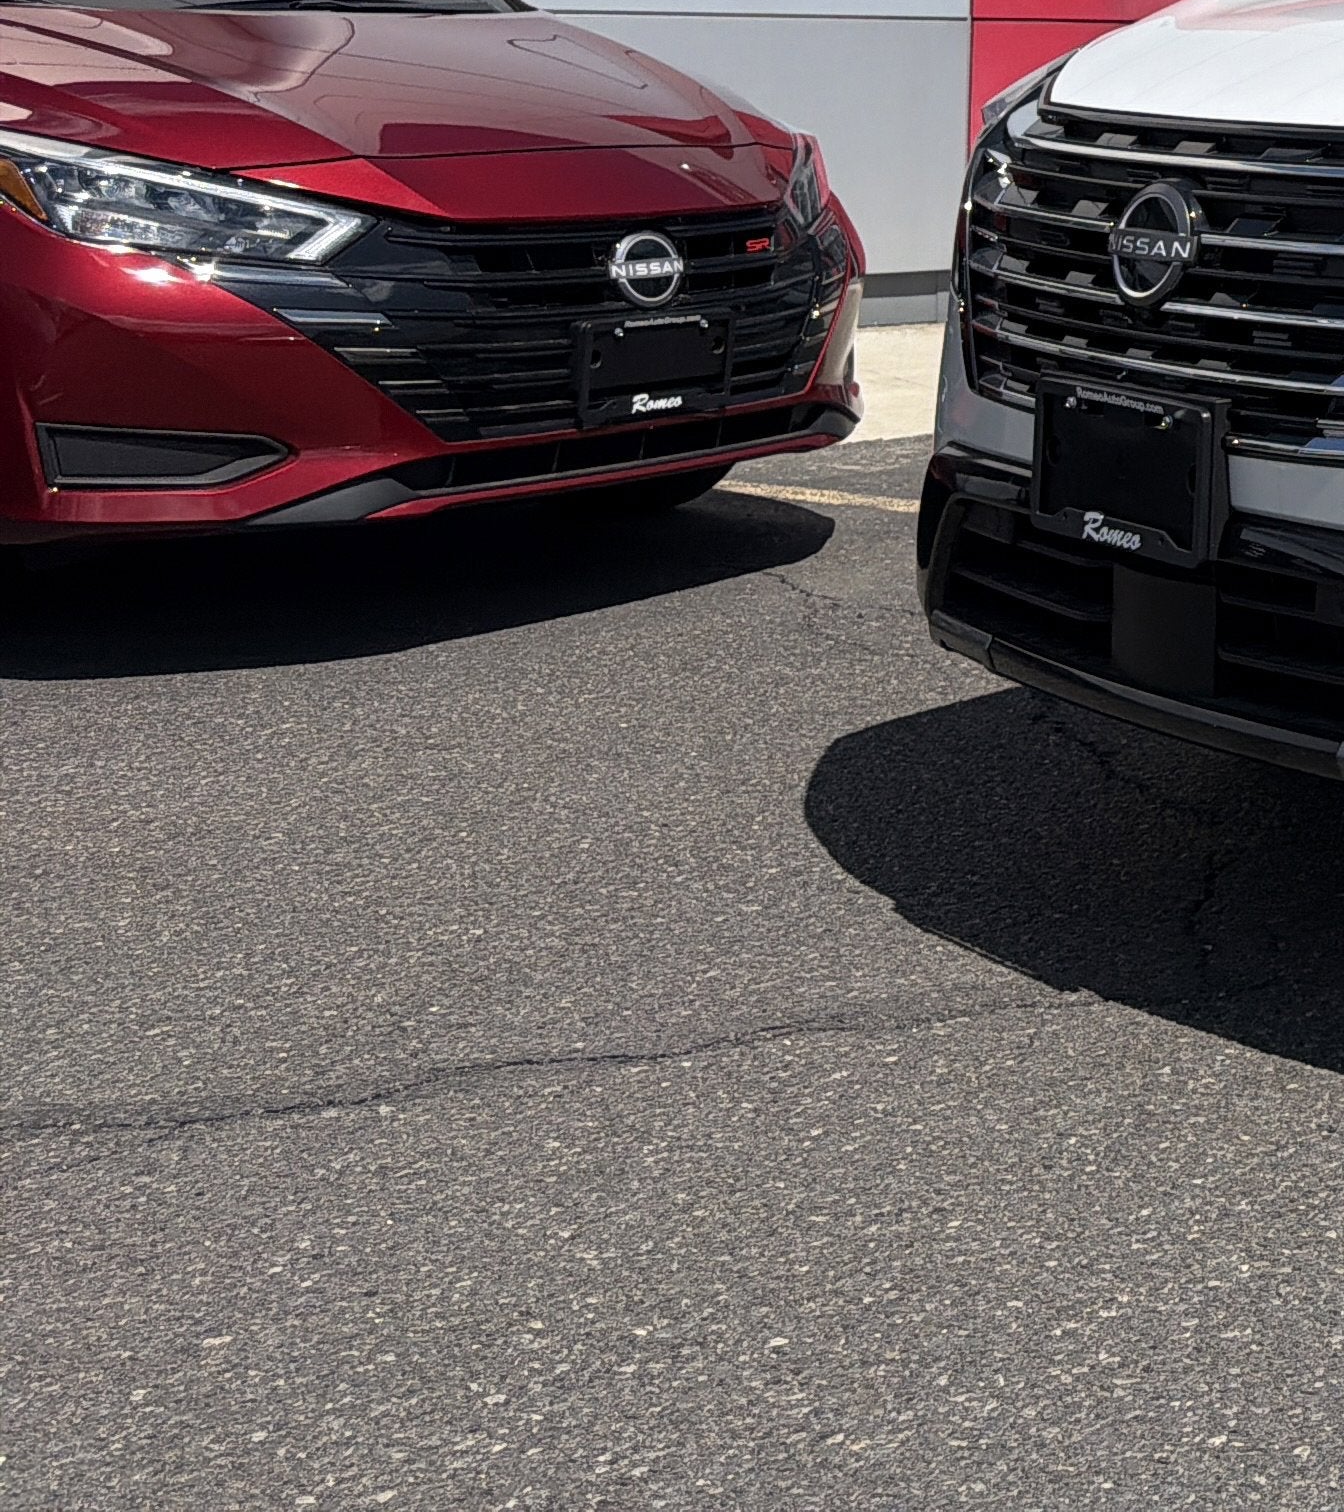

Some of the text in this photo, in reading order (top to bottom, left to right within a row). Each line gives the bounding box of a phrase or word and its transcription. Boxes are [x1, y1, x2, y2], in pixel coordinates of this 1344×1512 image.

[745, 238, 770, 253] SR
[1108, 232, 1191, 258] NISSAN
[611, 260, 684, 277] NISSAN
[631, 393, 683, 414] Romeo
[1082, 510, 1142, 550] Romeo
